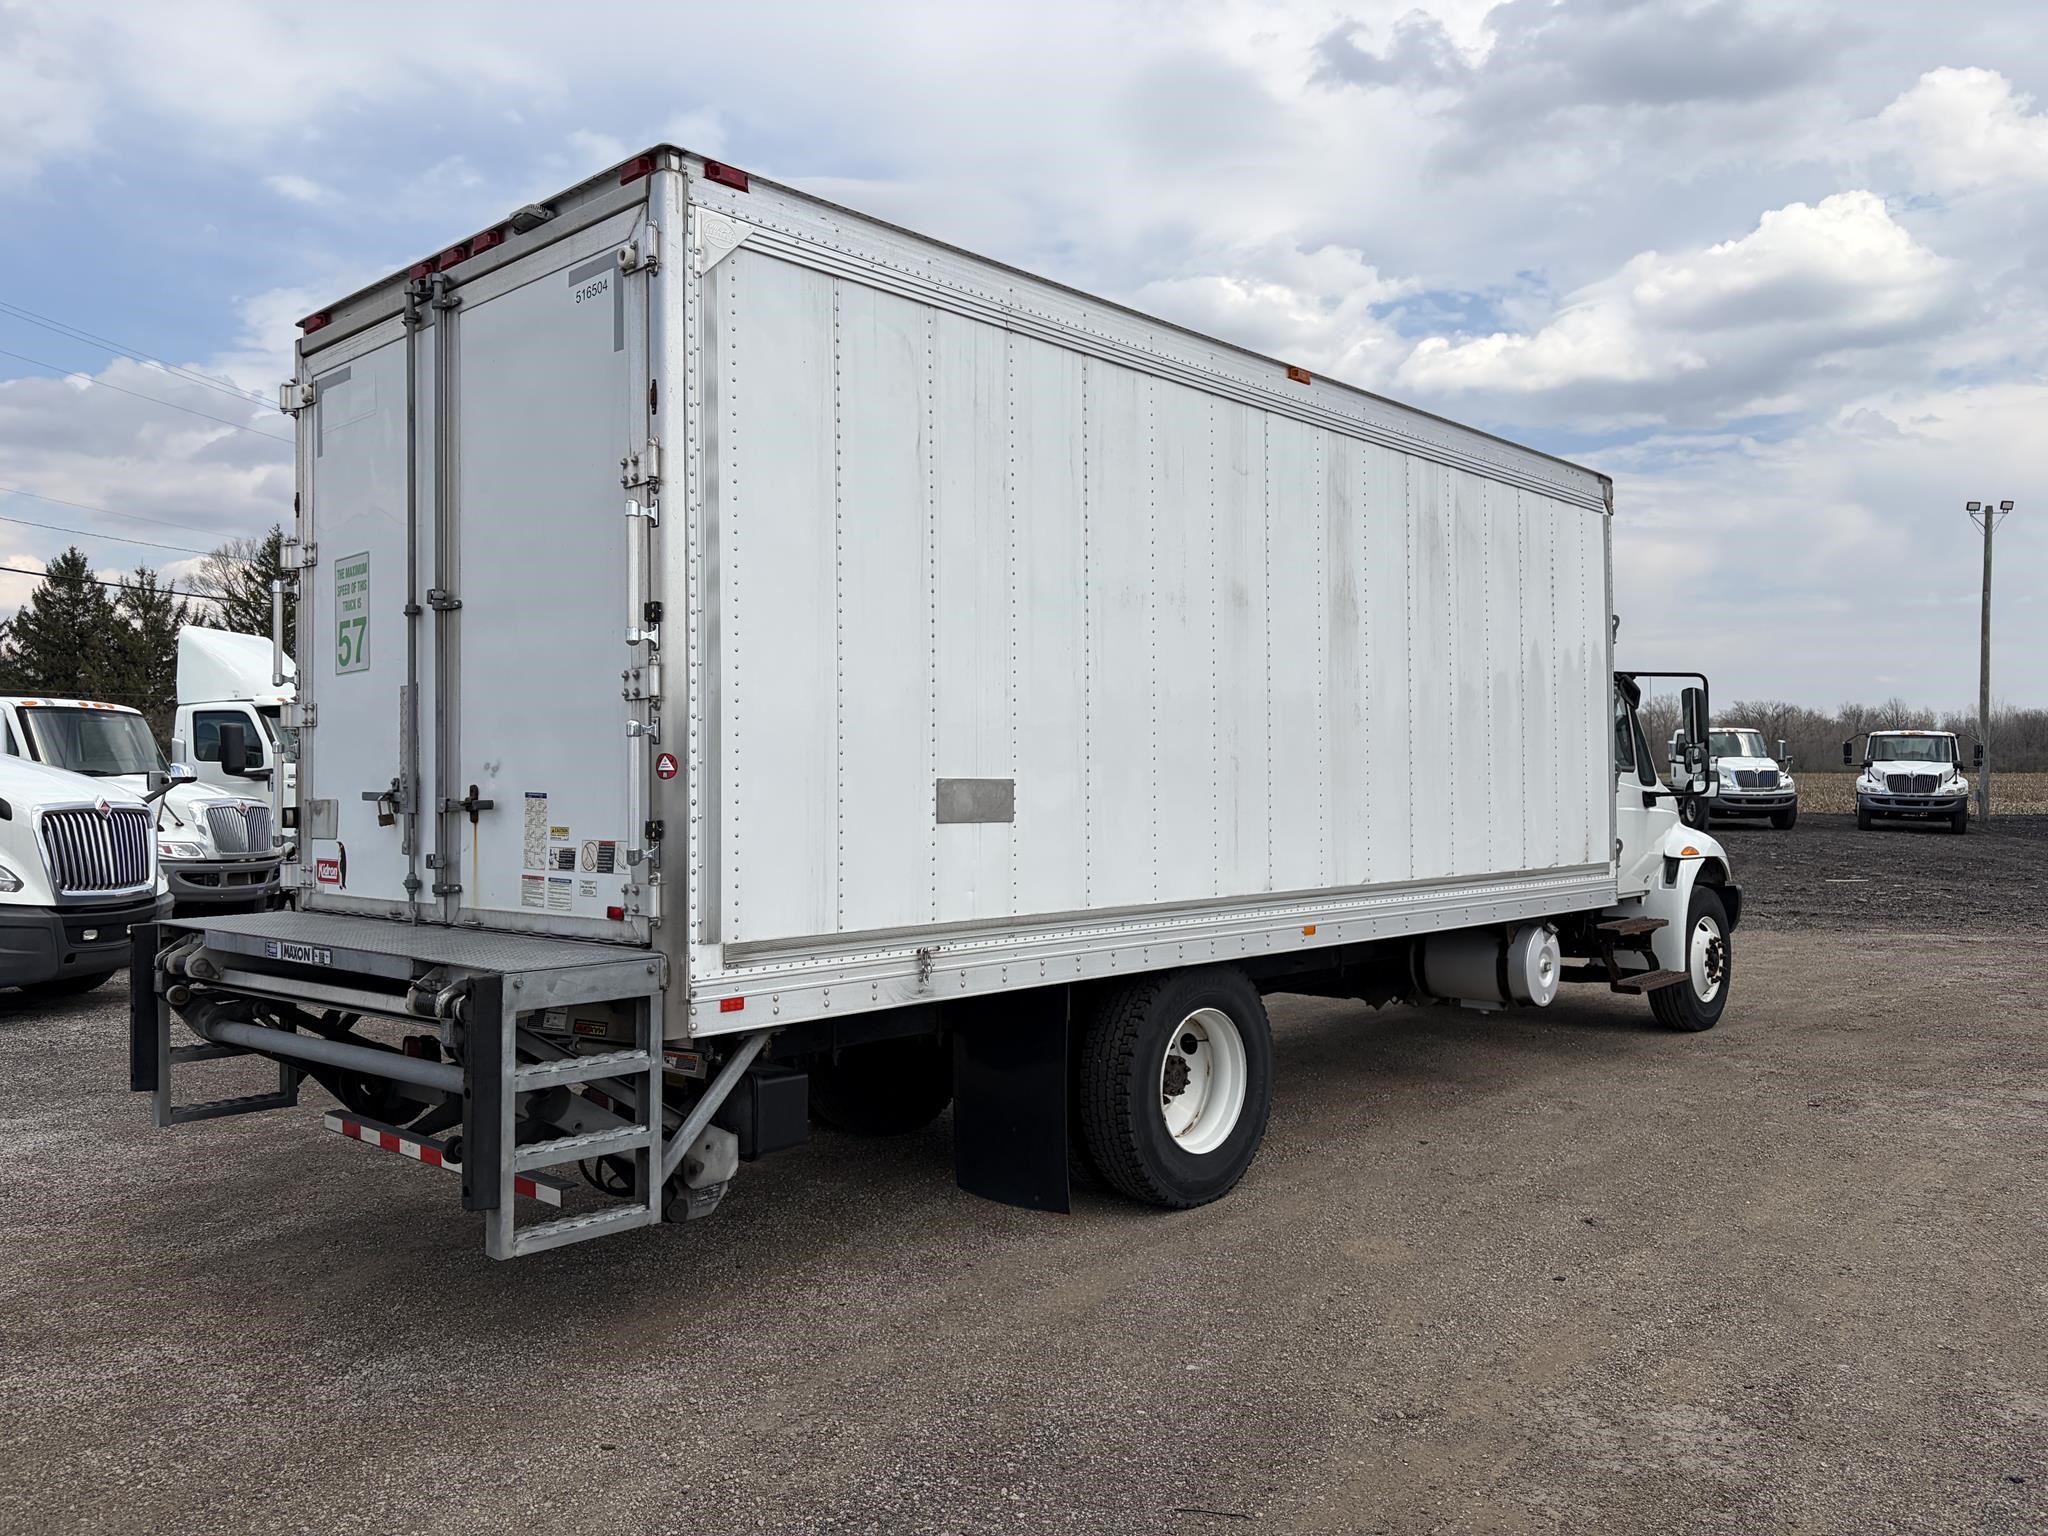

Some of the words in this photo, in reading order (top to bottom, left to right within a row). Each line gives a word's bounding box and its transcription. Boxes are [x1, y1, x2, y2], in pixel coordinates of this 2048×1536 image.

[575, 279, 608, 304] 516504
[345, 562, 367, 578] MAXIMUM
[337, 583, 350, 597] SPEED
[351, 581, 356, 594] OF
[357, 579, 367, 593] THIS
[342, 599, 356, 612] TRUCK
[357, 597, 362, 609] IS
[338, 616, 367, 667] 57
[318, 863, 338, 880] Kidron
[283, 944, 311, 962] MAXON
